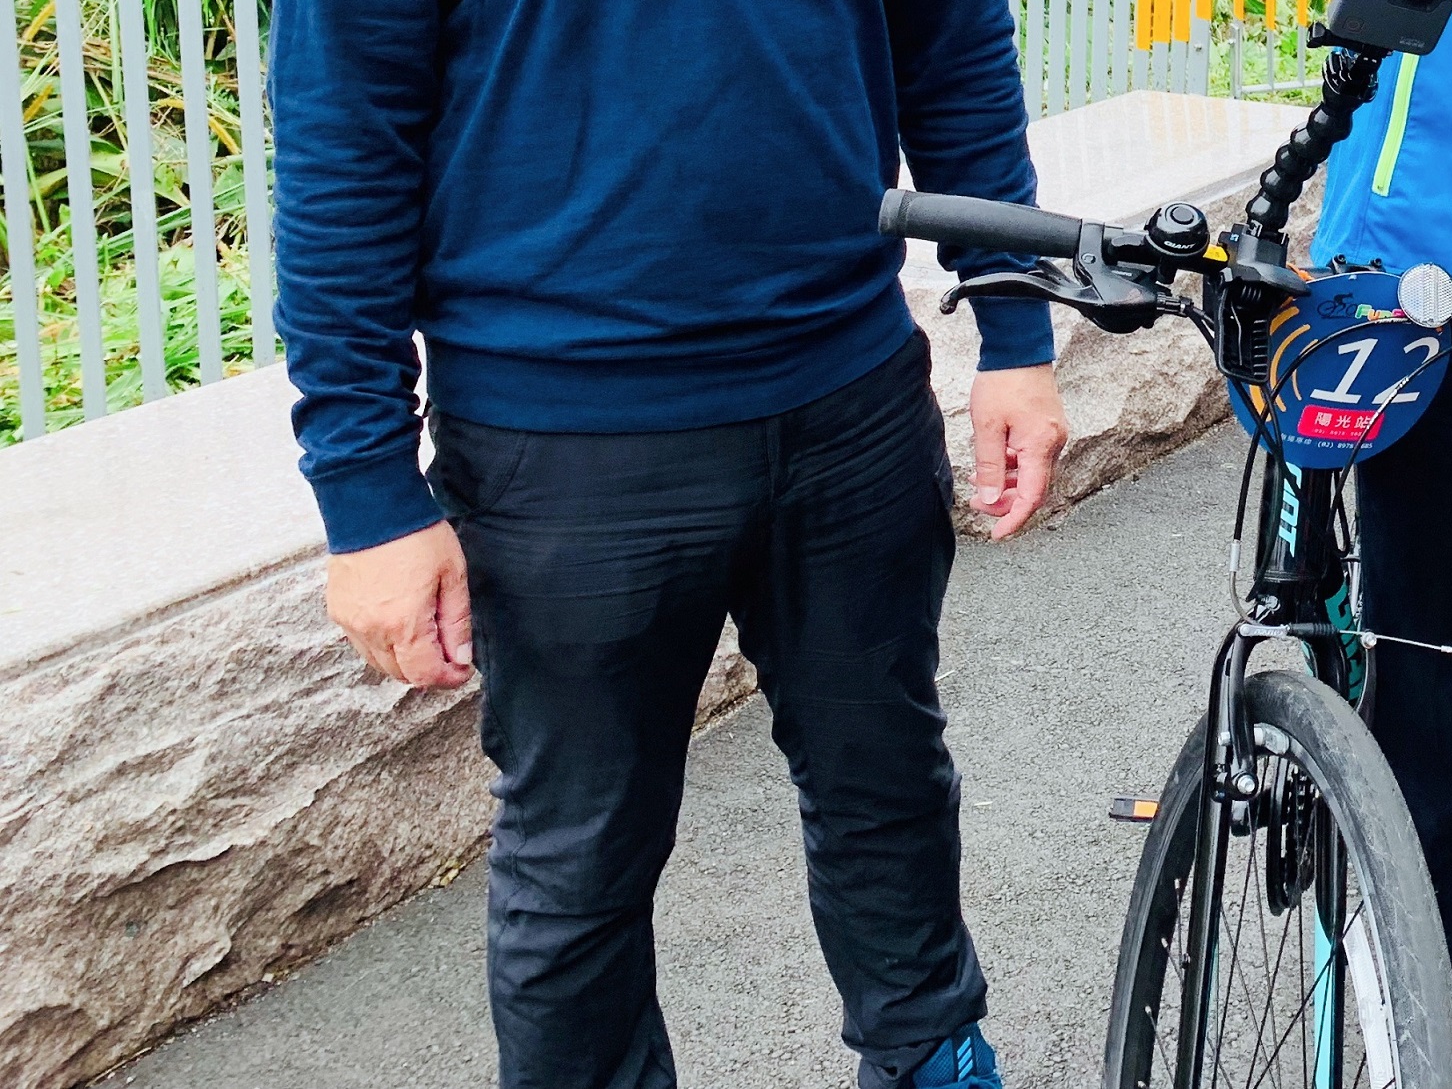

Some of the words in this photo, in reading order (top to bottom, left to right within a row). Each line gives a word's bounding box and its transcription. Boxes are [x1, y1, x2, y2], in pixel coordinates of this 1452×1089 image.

[1163, 240, 1197, 250] GIANT
[1310, 336, 1440, 404] 12
[1314, 411, 1372, 429] 陽光站
